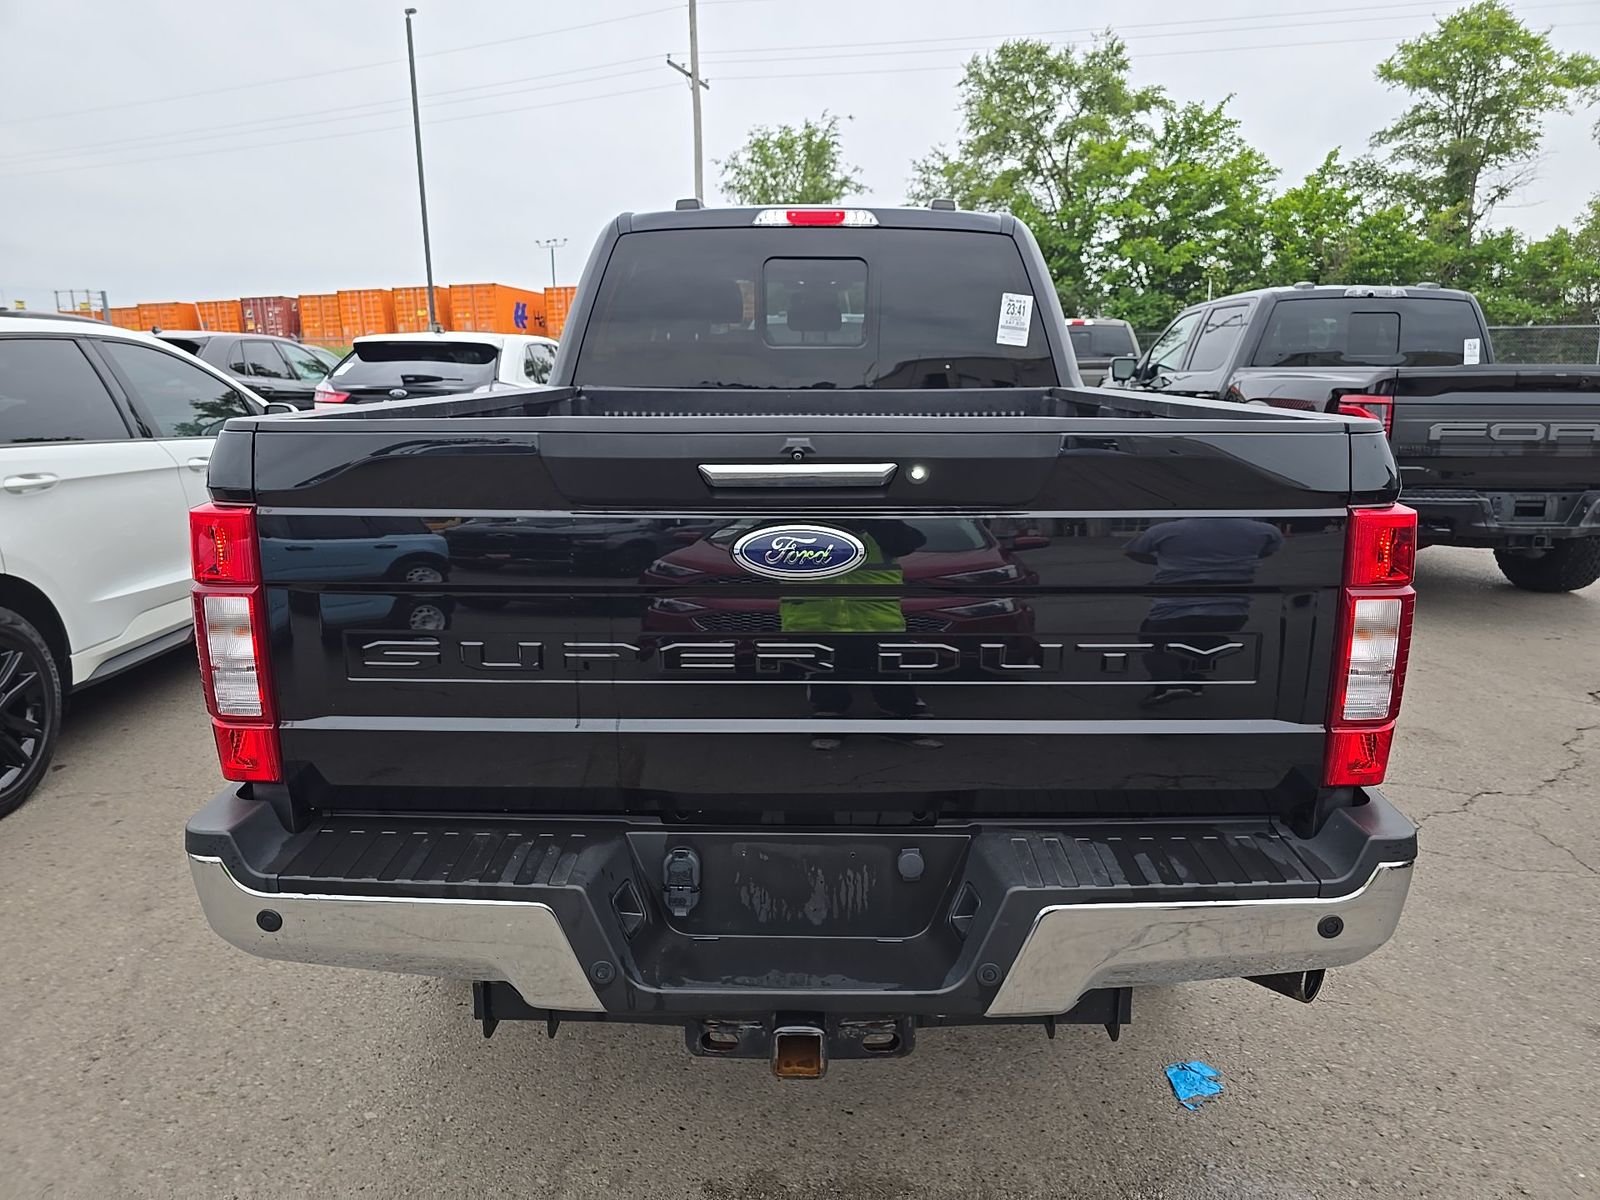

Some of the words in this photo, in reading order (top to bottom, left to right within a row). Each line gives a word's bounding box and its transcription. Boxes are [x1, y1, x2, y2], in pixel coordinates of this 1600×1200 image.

[764, 536, 834, 565] Ford
[361, 639, 836, 672] SUPER
[877, 642, 1245, 674] DUTY
